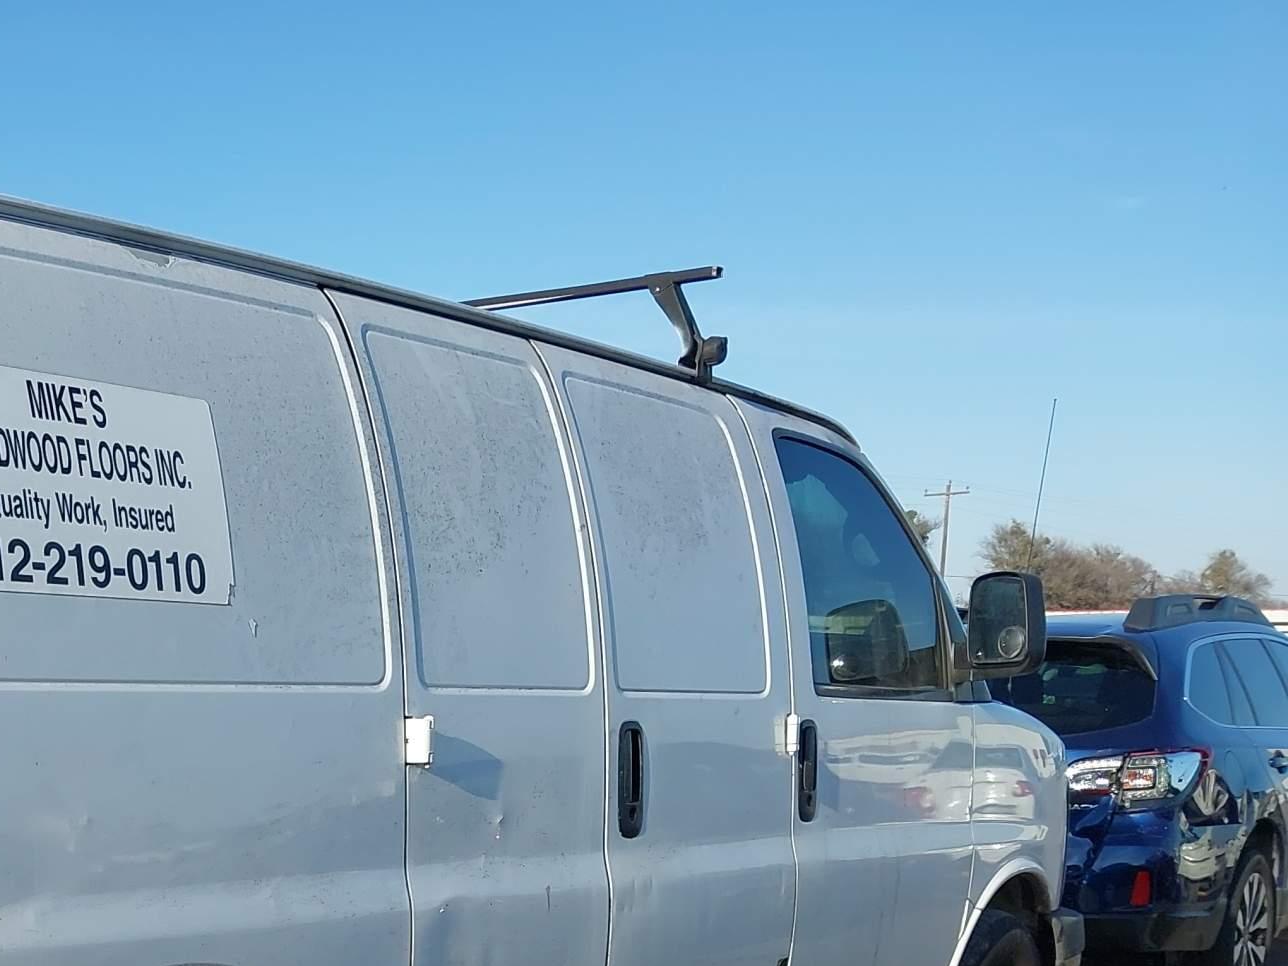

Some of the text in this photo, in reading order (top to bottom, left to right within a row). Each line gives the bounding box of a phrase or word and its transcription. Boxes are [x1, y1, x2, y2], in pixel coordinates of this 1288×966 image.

[25, 379, 107, 428] MIKE'S
[74, 437, 153, 485] FLOORS
[154, 448, 192, 489] INC.
[55, 492, 107, 532] Work,
[112, 498, 176, 532] Insured
